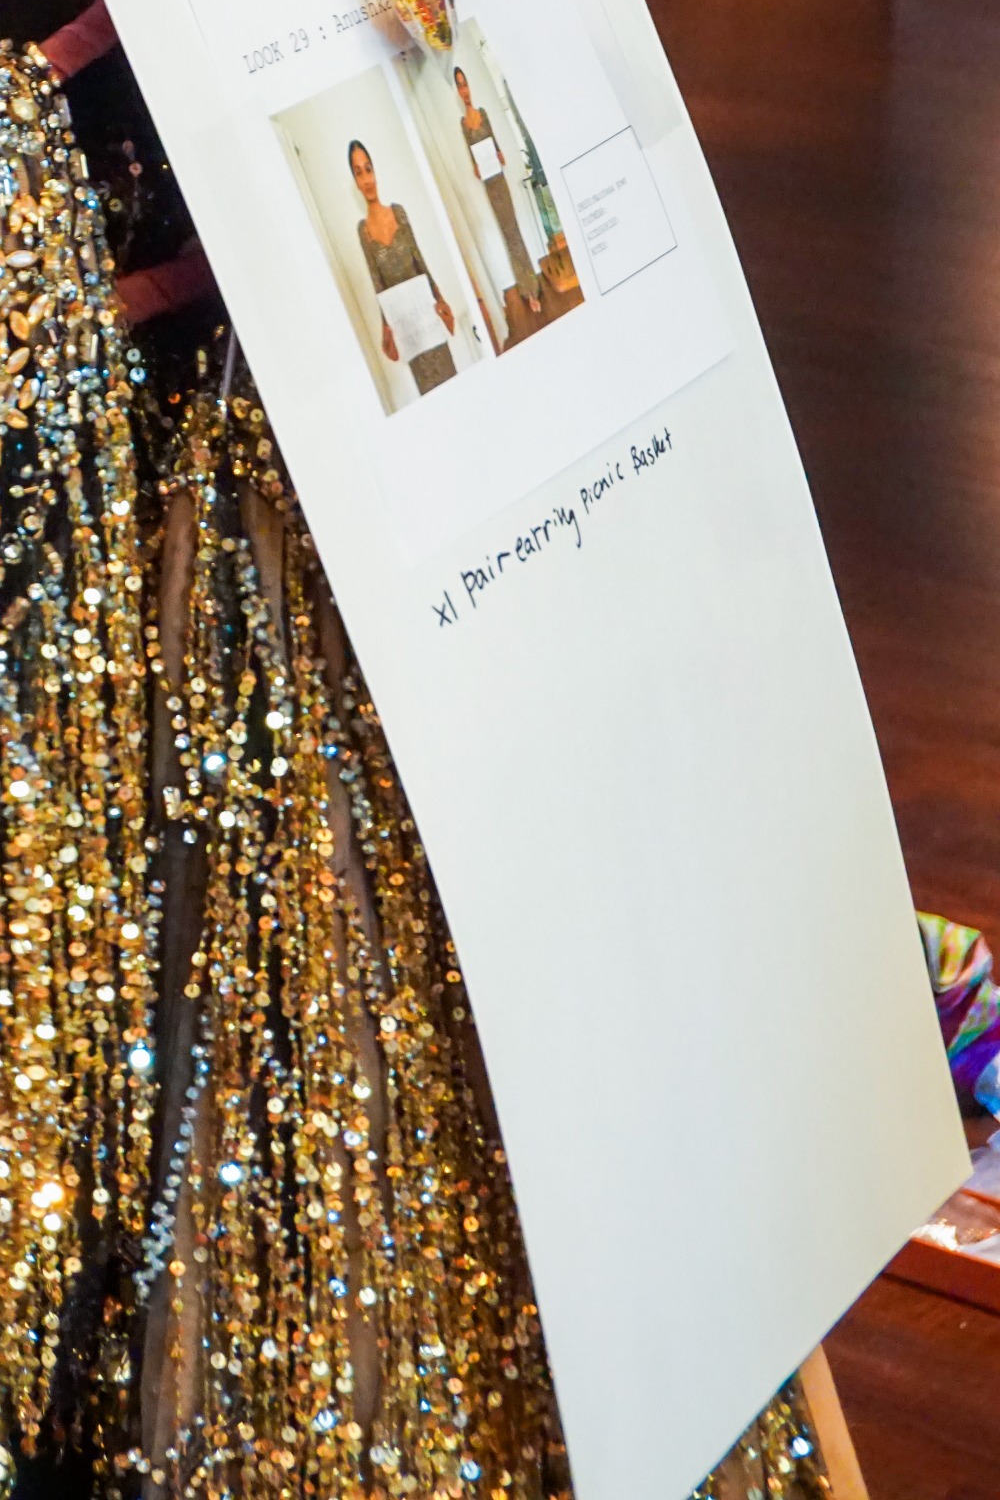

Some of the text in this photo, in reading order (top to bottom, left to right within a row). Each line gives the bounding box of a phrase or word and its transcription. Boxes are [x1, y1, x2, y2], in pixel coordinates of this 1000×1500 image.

[242, 41, 285, 74] LOOK
[289, 28, 310, 53] 29
[460, 551, 510, 608] pair
[515, 507, 581, 562] earring
